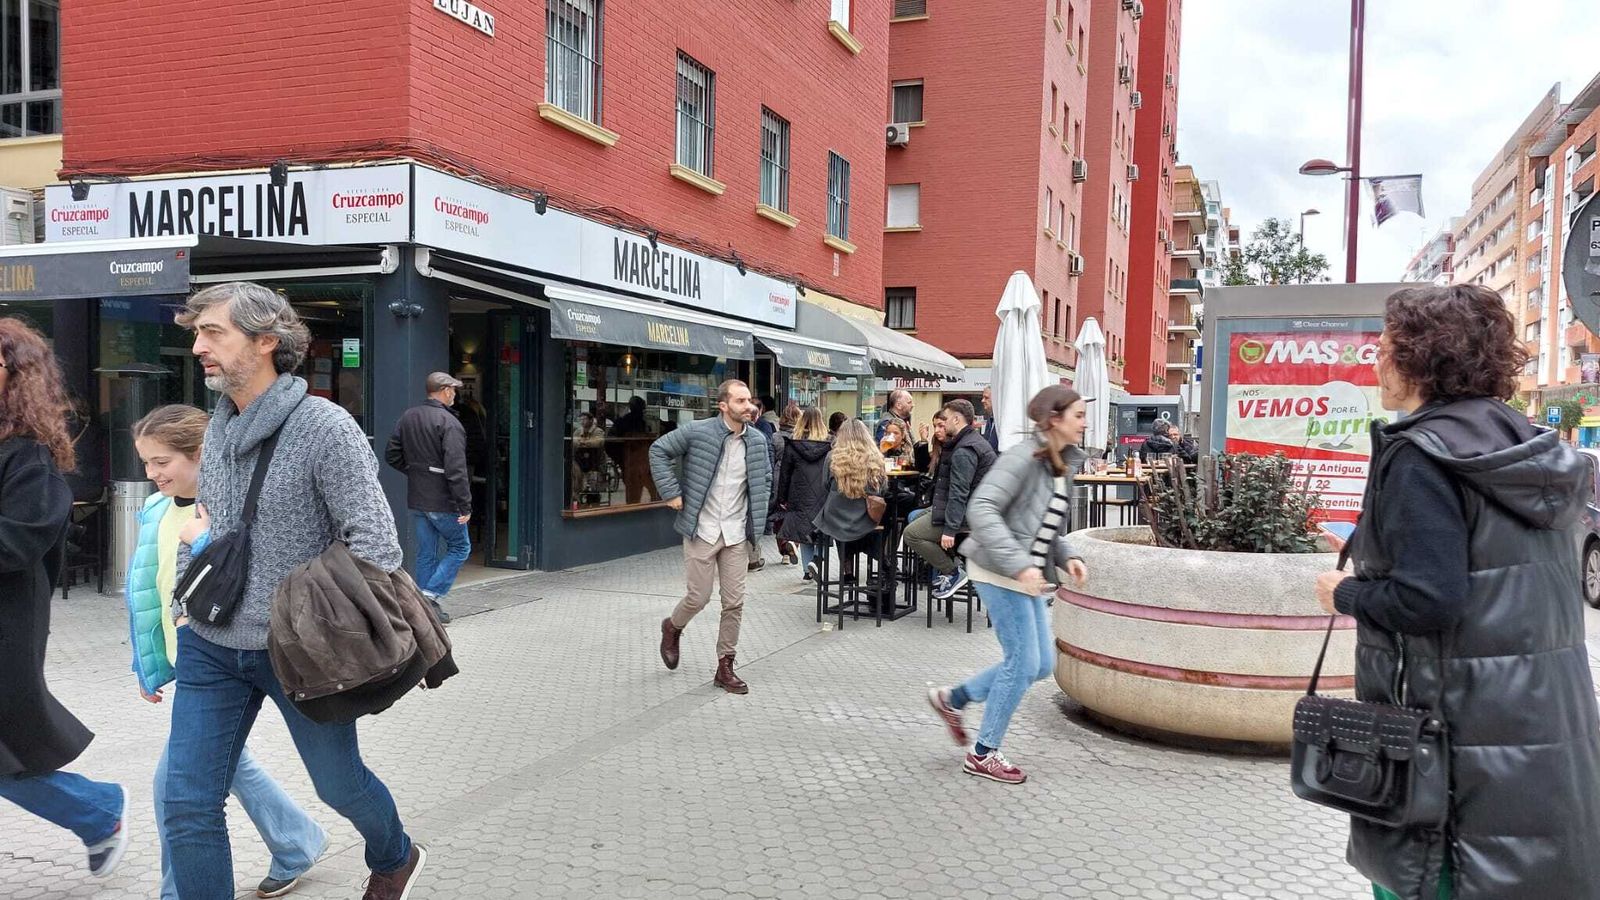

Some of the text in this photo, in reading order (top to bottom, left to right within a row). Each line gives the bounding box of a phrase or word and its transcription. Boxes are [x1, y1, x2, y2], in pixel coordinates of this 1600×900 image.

[332, 192, 404, 208] Cruzcampo
[51, 207, 109, 223] Cruzcampo
[129, 181, 309, 238] MARCELINA
[434, 196, 489, 225] Cruzcampo
[346, 212, 391, 224] ESPECIAL
[62, 226, 98, 237] ESPECIAL
[445, 220, 480, 238] ESPECIAL
[110, 259, 163, 274] Cruzcampo
[614, 237, 701, 300] MARCELINA
[120, 276, 153, 287] ESPECIAL
[647, 321, 690, 347] MARCELINA
[1238, 396, 1330, 419] VEMOS
[1331, 406, 1348, 414] POR
[1320, 463, 1364, 475] Antigua,
[1315, 479, 1331, 489] 22
